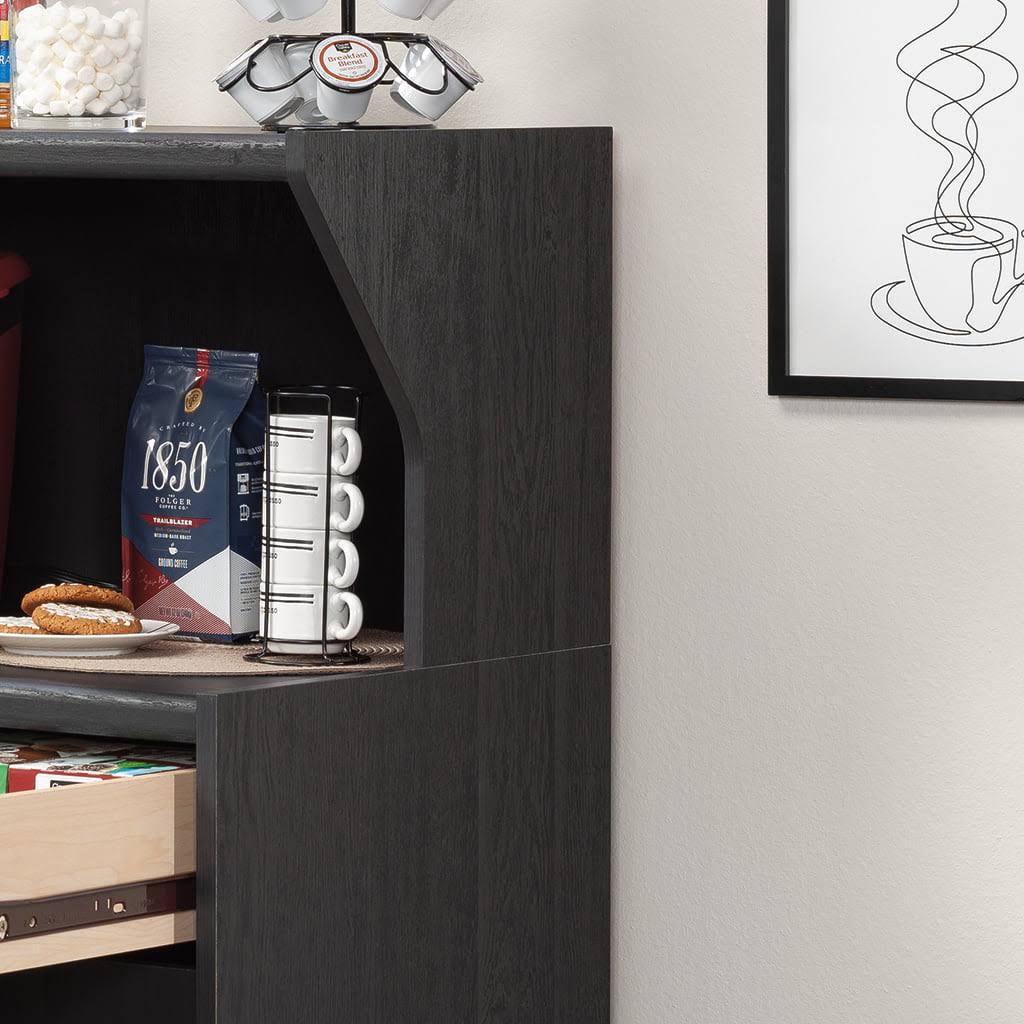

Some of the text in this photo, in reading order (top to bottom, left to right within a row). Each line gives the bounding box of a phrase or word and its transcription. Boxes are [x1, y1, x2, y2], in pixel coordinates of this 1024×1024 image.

[327, 51, 369, 63] Breakfast
[337, 58, 363, 68] Blend
[141, 438, 208, 493] 1850
[154, 496, 192, 506] FOLGER
[153, 517, 193, 526] TRAILBLAZER
